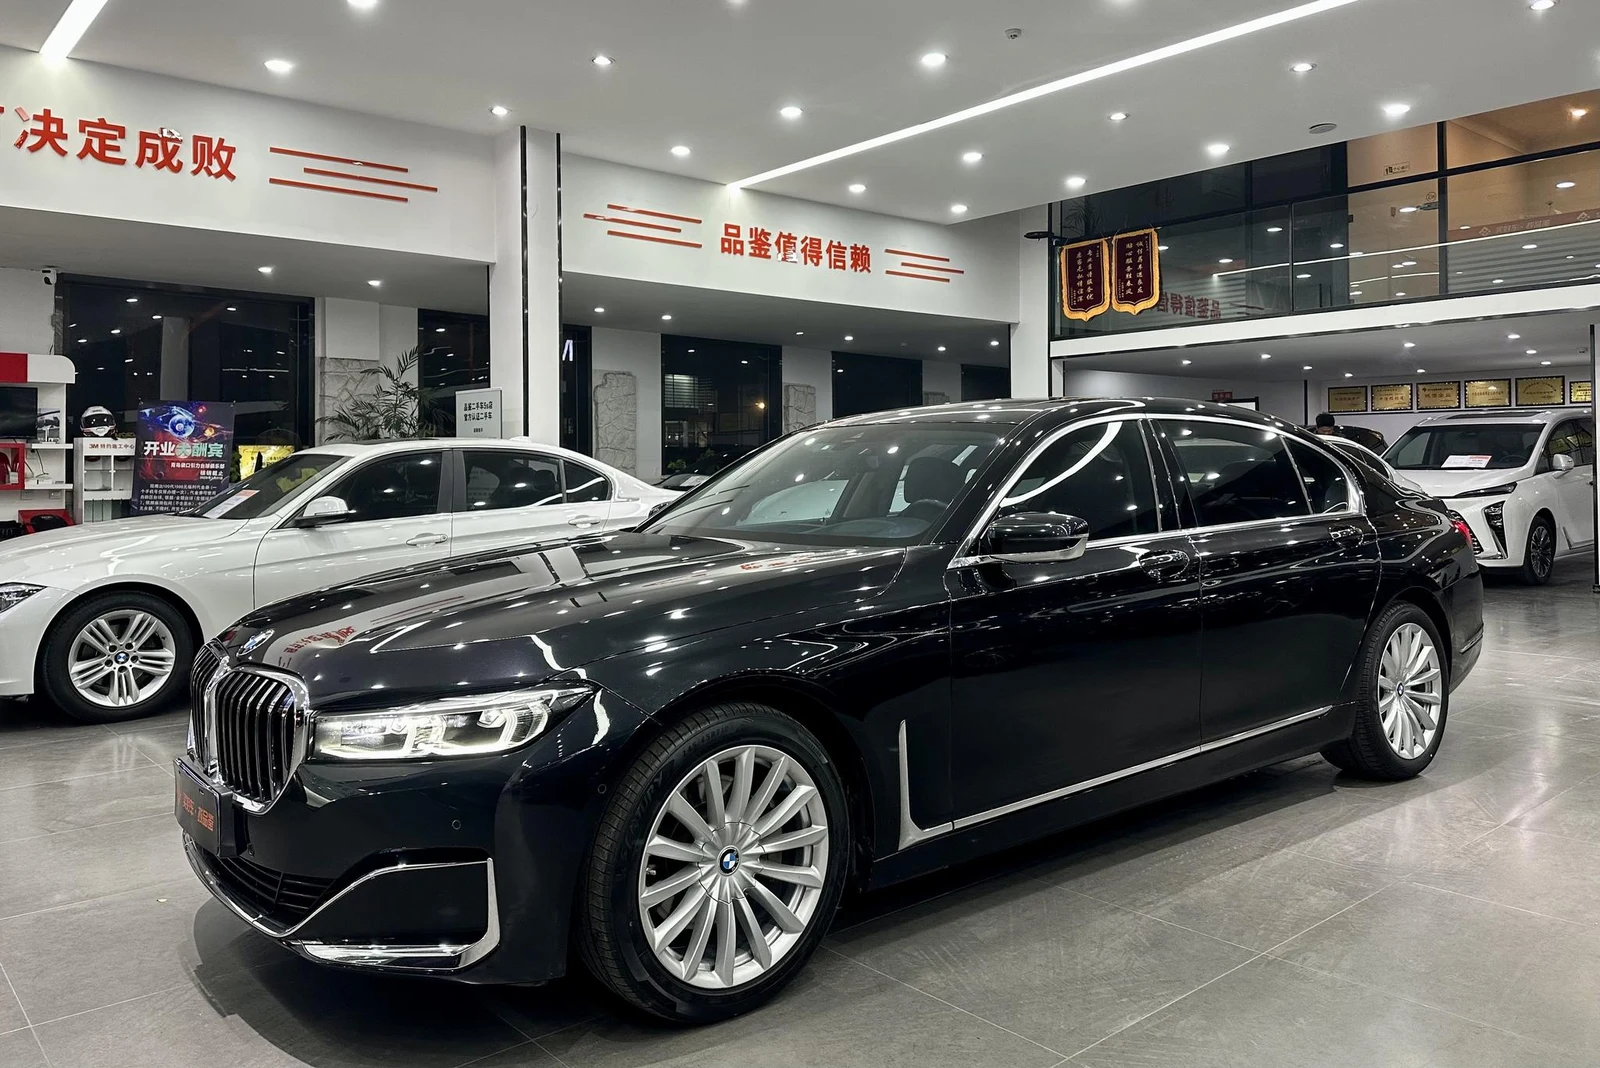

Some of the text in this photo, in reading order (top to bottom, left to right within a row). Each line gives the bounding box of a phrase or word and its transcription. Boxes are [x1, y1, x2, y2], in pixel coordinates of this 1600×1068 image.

[0, 106, 235, 180] 决定成败
[721, 224, 870, 271] 品鉴值得信赖
[144, 441, 224, 458] 开业大酬宾
